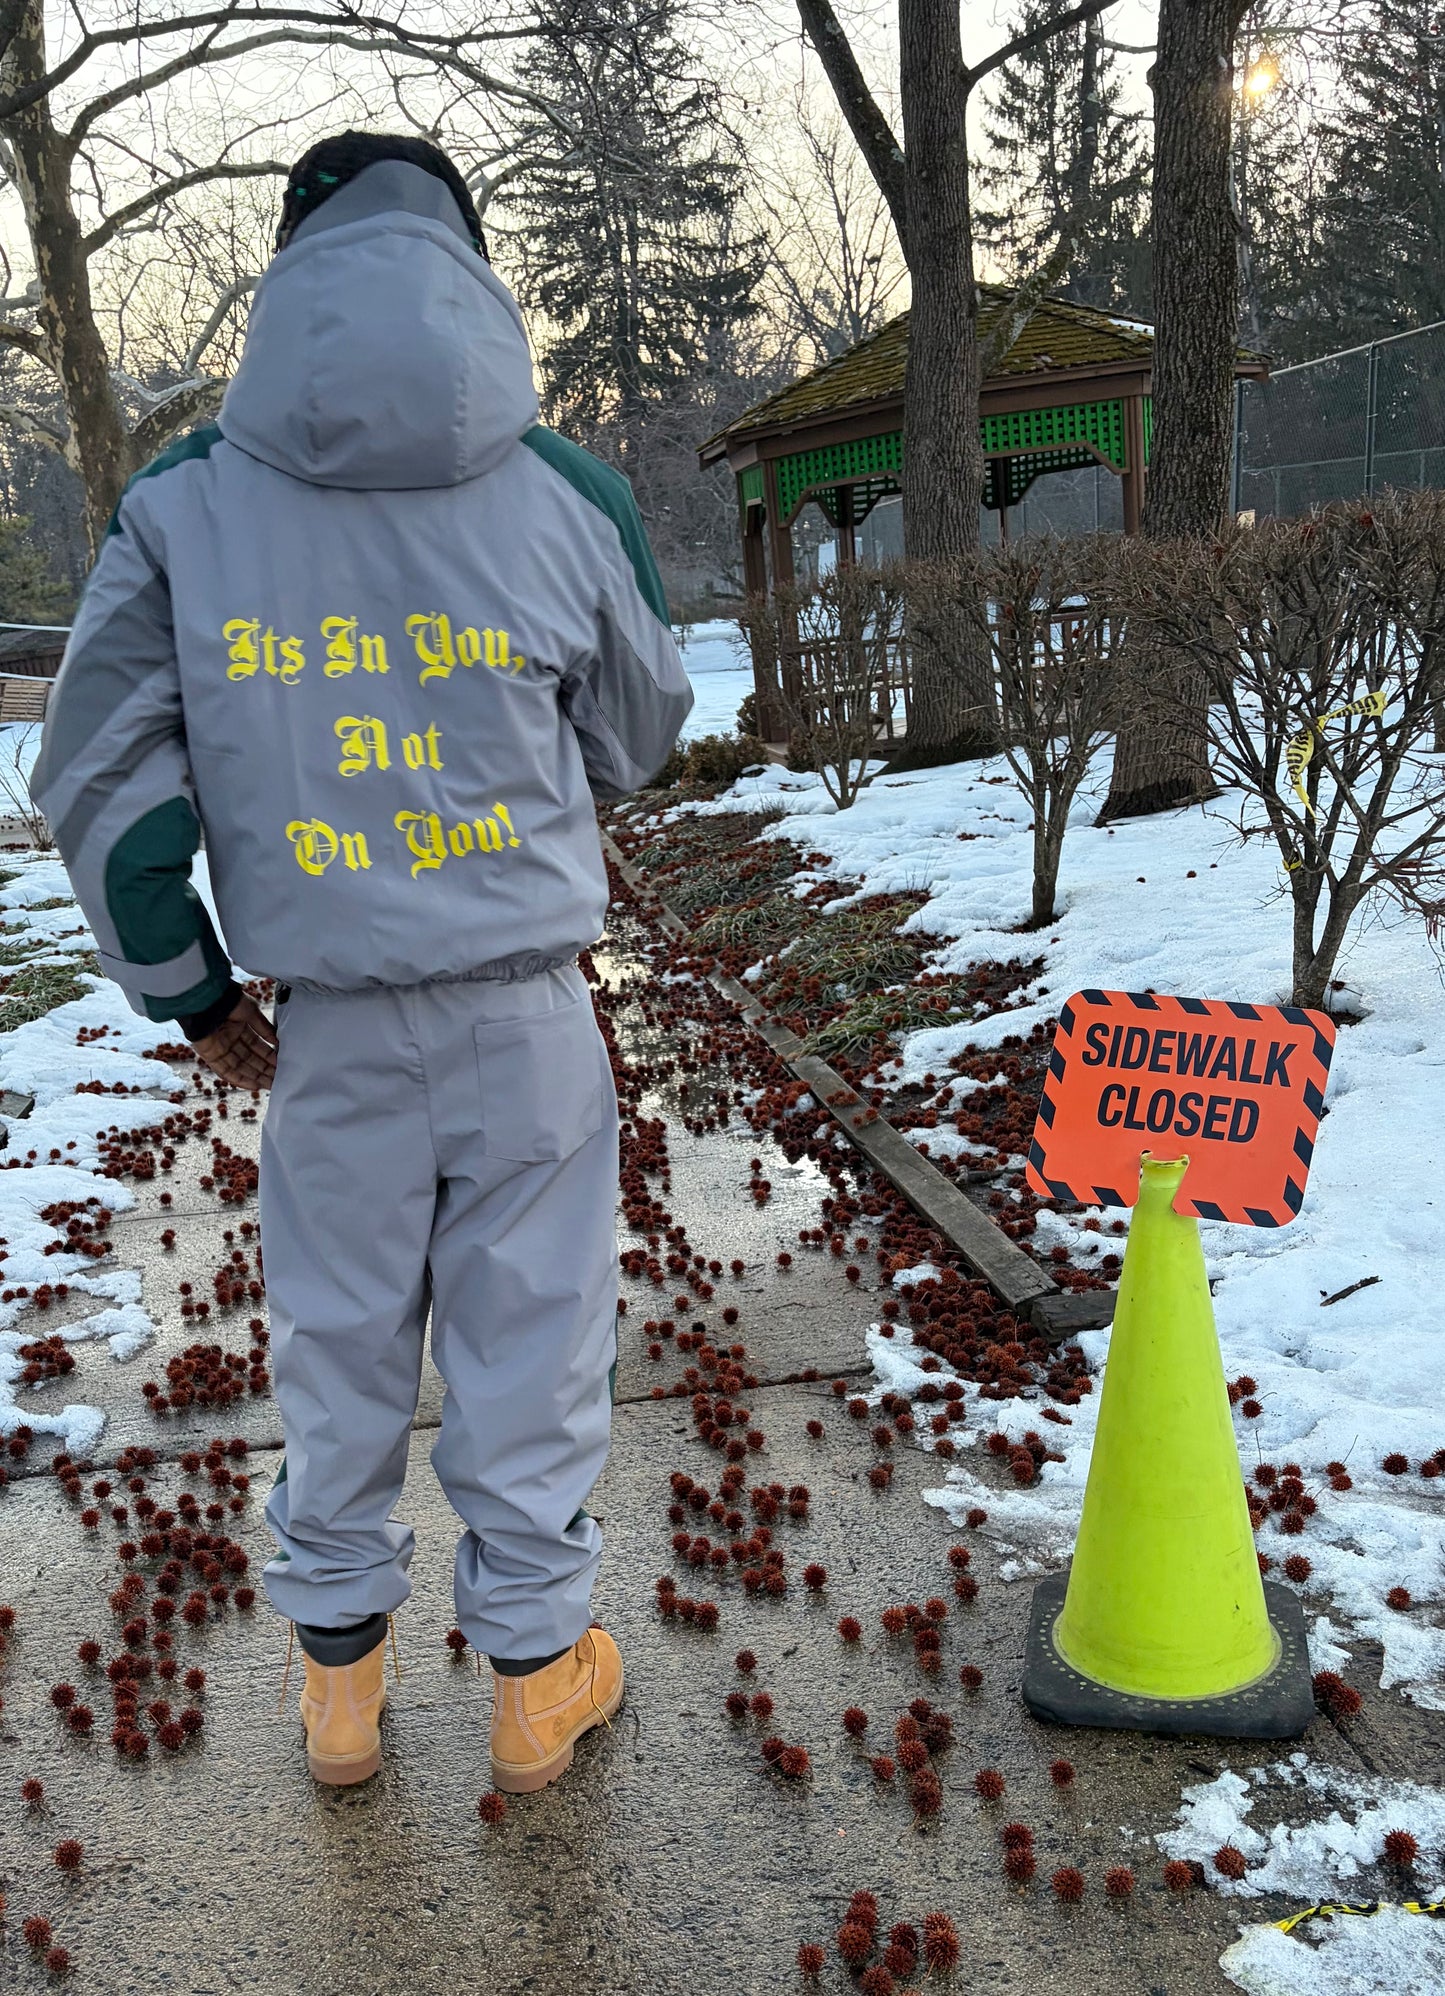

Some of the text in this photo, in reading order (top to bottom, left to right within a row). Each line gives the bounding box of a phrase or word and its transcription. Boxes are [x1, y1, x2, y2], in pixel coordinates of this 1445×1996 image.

[222, 611, 526, 688] Its In You,
[333, 714, 445, 778] Not
[285, 801, 522, 880] On You!
[1081, 1022, 1299, 1088] SIDEWALK
[1096, 1083, 1260, 1144] CLOSED
